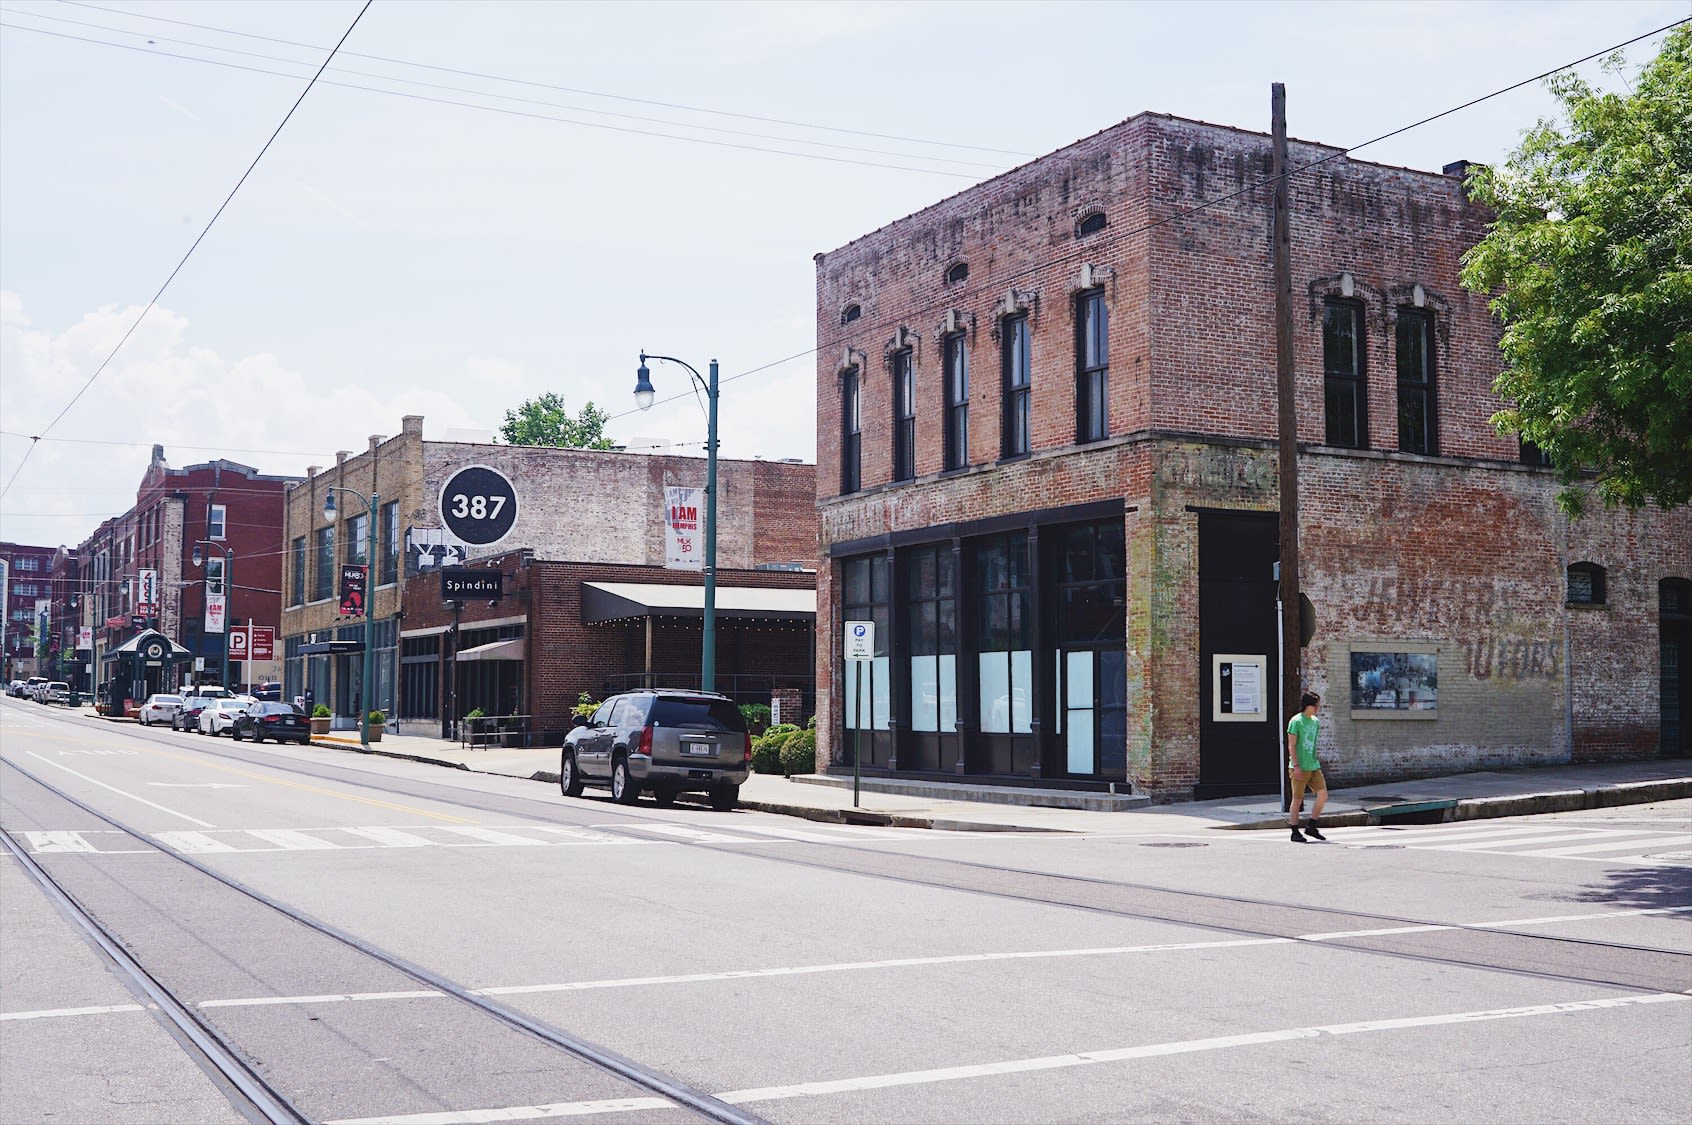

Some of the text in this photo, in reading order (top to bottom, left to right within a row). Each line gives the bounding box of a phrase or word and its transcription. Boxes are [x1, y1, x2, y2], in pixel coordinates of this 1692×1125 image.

[452, 494, 506, 520] 387
[678, 507, 697, 521] AM
[672, 522, 697, 530] MEMPHIS
[447, 580, 497, 591] Spindini
